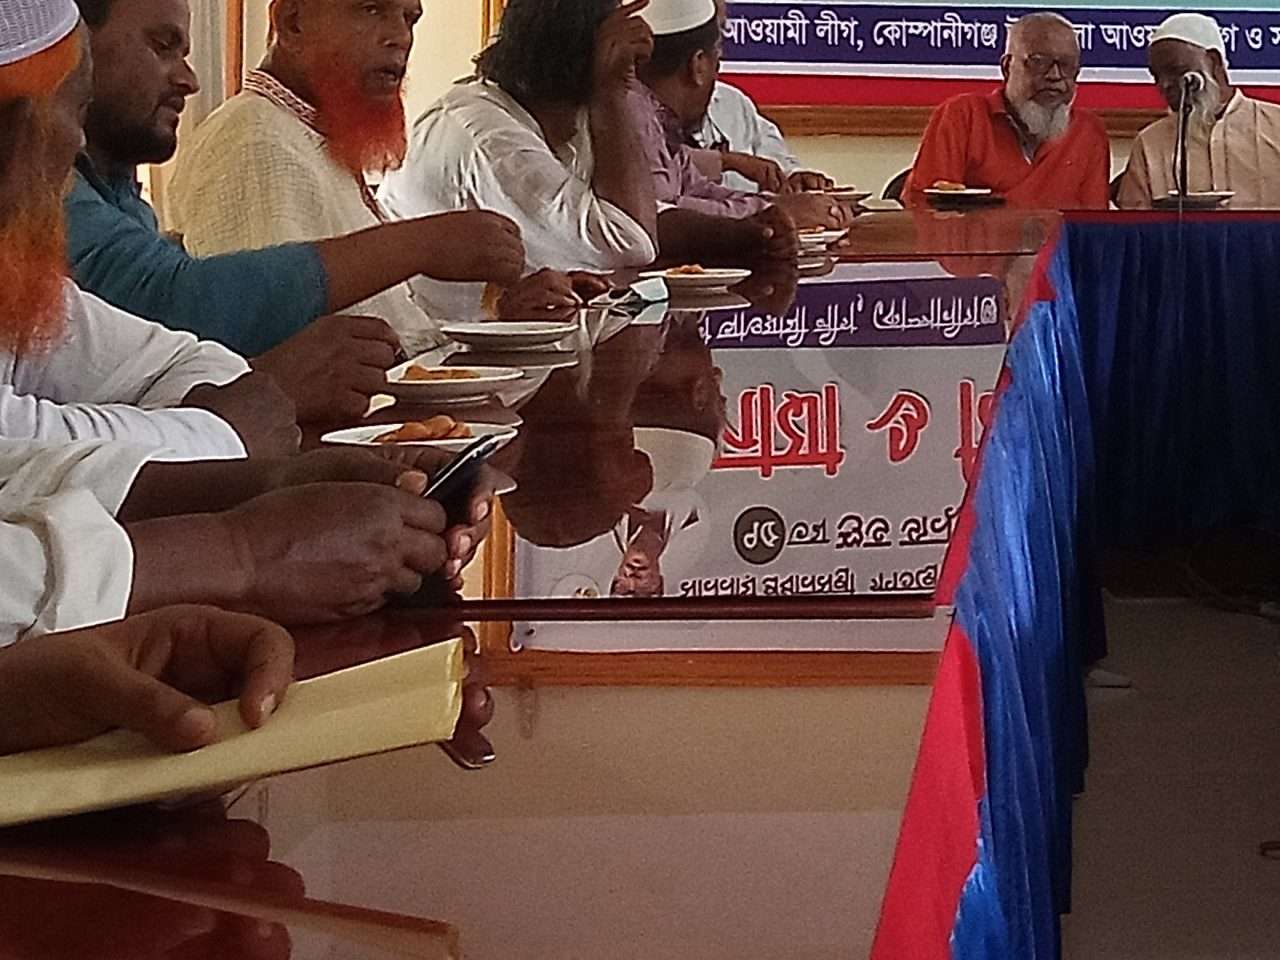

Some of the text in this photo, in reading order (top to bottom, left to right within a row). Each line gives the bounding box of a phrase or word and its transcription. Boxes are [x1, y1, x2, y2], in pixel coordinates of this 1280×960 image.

[721, 10, 809, 46] আওয়ামী
[814, 10, 864, 51] লীগ,
[873, 12, 998, 49] কোম্পানীগঞ্জ
[1245, 25, 1262, 49] ও
